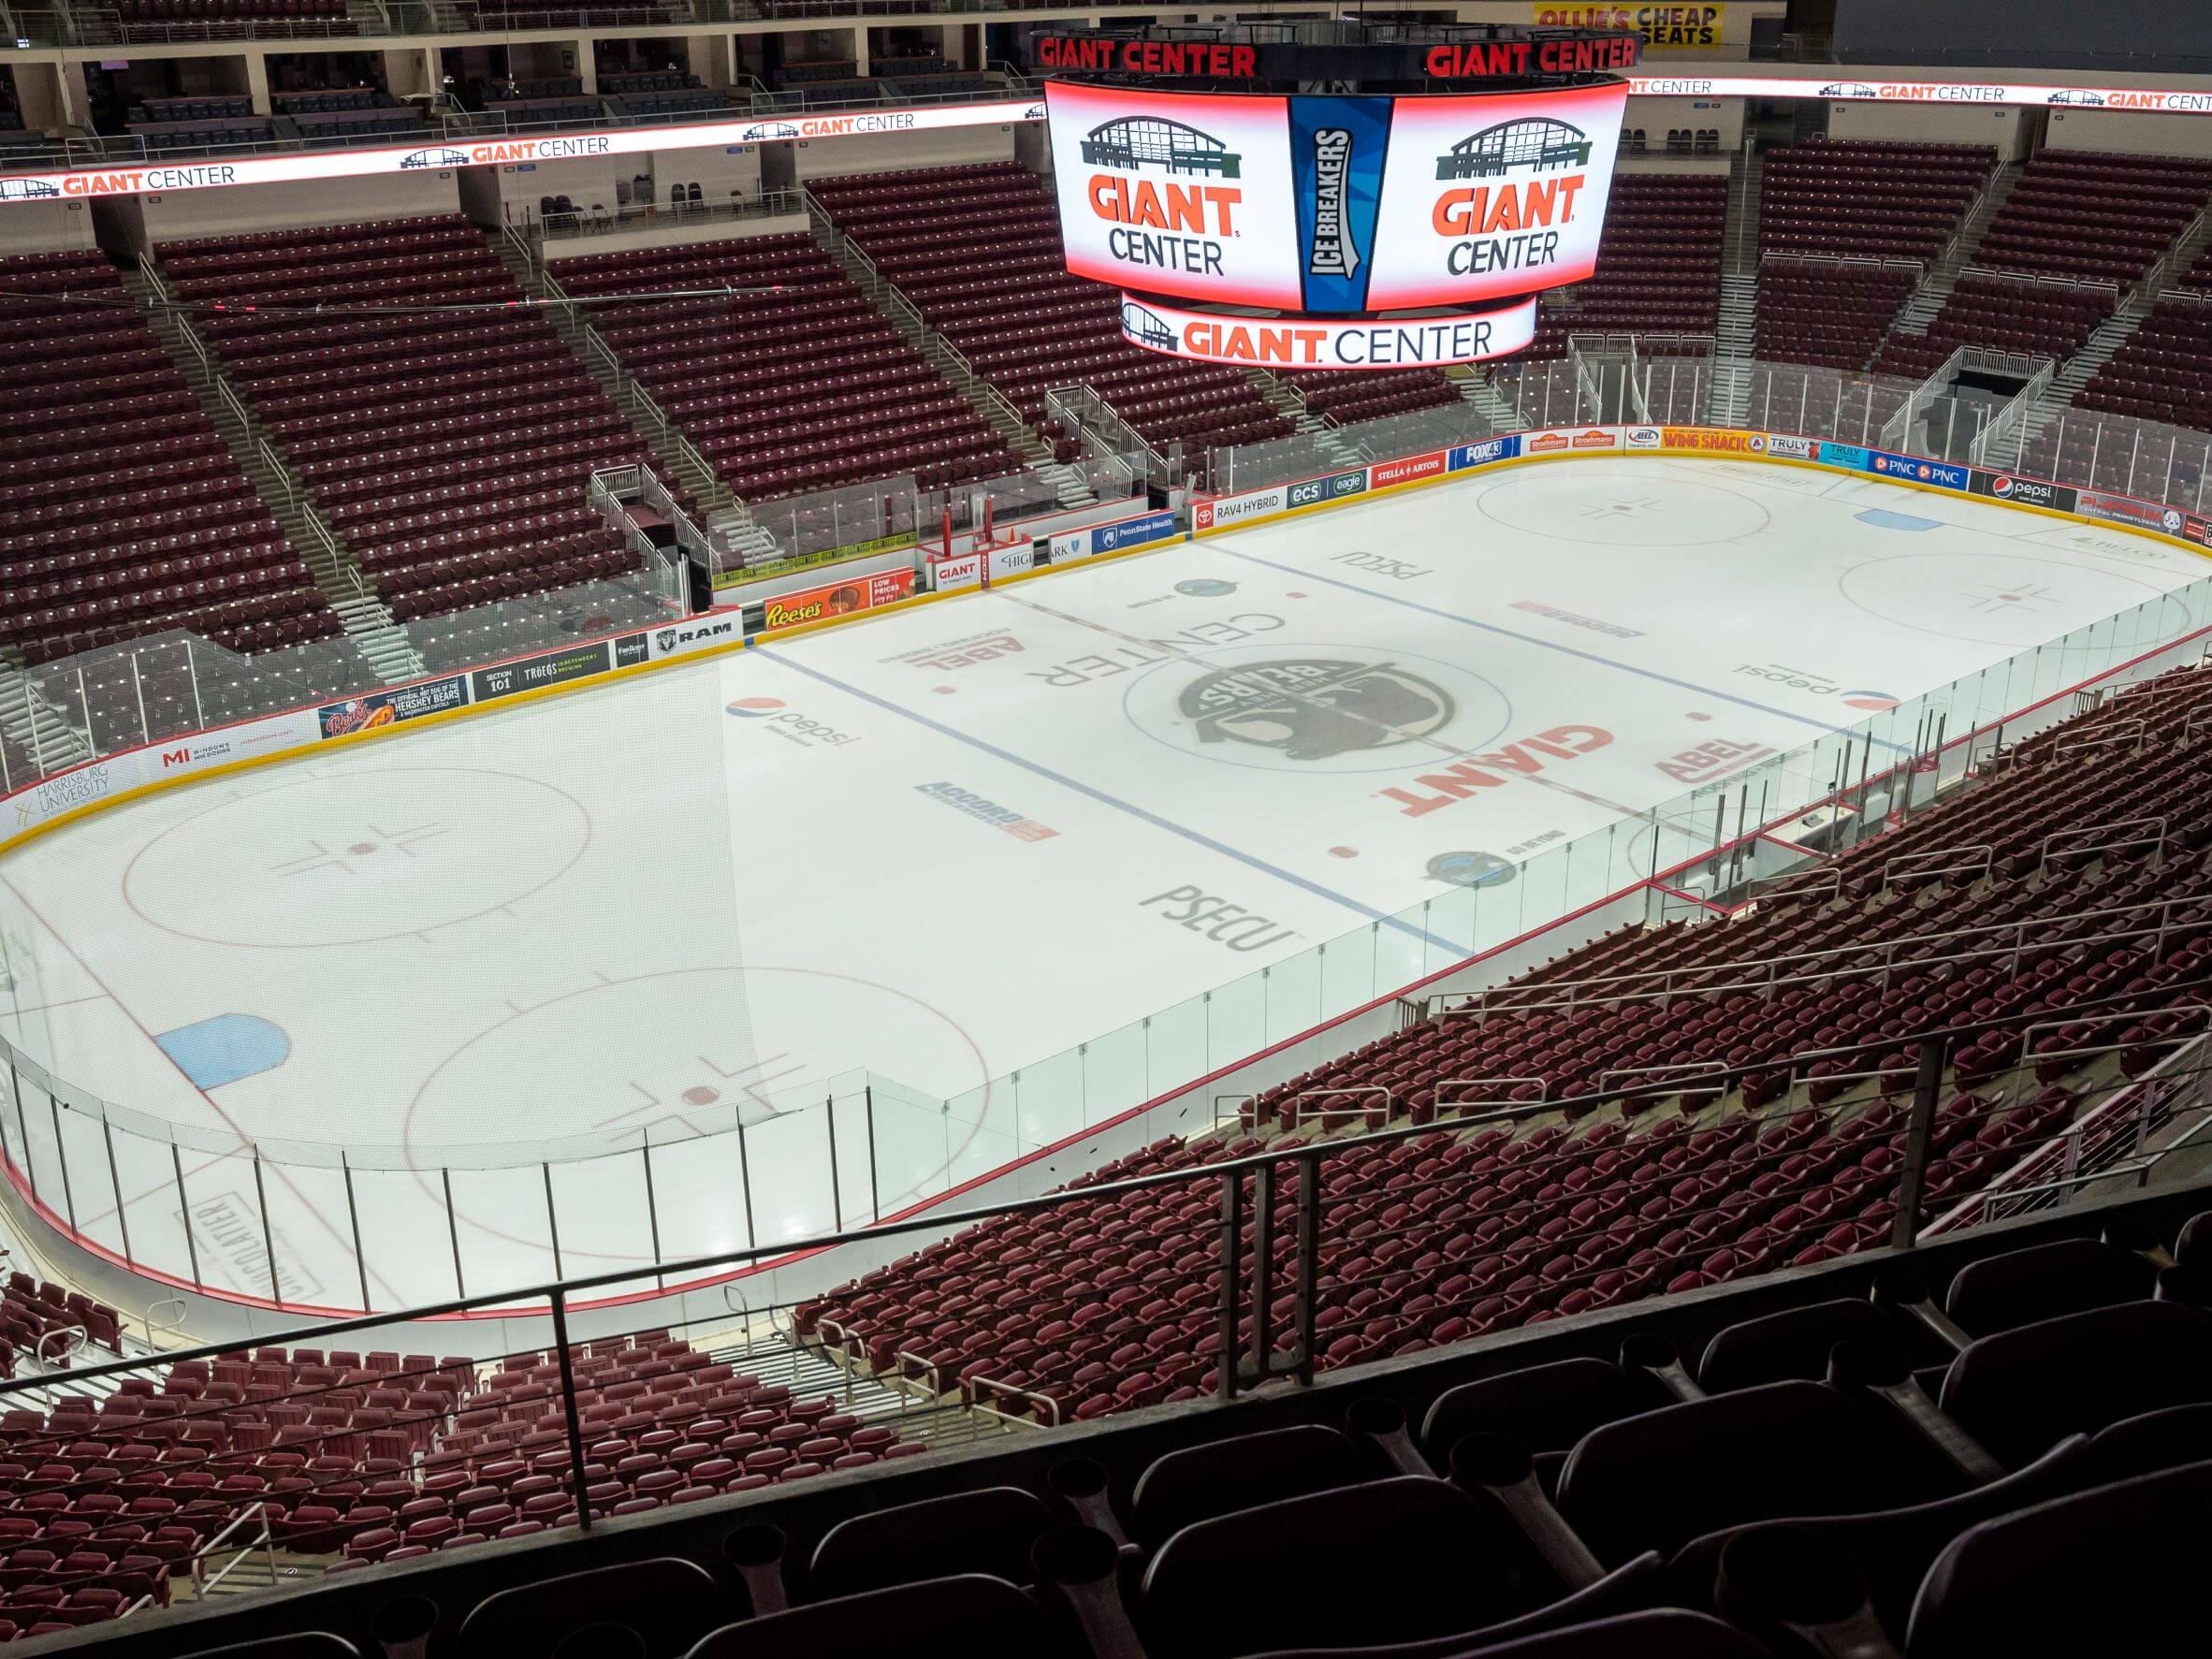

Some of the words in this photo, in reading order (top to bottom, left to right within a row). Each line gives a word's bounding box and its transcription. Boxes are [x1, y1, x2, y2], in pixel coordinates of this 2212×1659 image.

[1637, 7, 1717, 26] CHEAP
[1637, 26, 1714, 45] SEATS
[1040, 36, 1114, 70] GIANT
[1123, 41, 1256, 77] CENTER
[1426, 43, 1532, 78] GIANT
[1539, 37, 1637, 72] CENTER
[1651, 80, 1711, 94] CENTER
[1879, 85, 1936, 99] GIANT
[1938, 86, 2004, 101] CENTER
[2107, 93, 2166, 108] GIANT
[801, 119, 854, 136] GIANT
[856, 113, 914, 132] CENTER
[472, 142, 535, 162] GIANT
[539, 138, 608, 157] CENTER
[63, 172, 143, 195] GIANT
[147, 166, 234, 188] CENTER
[1316, 129, 1350, 236] BREAKERS
[1088, 174, 1242, 238] GIANT
[1432, 174, 1585, 238] GIANT
[1109, 227, 1224, 276] CENTER
[1310, 237, 1341, 275] ICE
[1447, 230, 1559, 276] CENTER
[1183, 321, 1327, 364] GIANT
[1334, 320, 1492, 365] CENTER
[1531, 439, 1566, 448] Stroehmann
[1575, 435, 1613, 444] Stroehmann
[1634, 429, 1654, 440] AHL
[1663, 432, 1699, 448] WING
[1701, 434, 1747, 451] SHACK
[1770, 437, 1807, 450] TRULY
[1466, 441, 1503, 462] FOX43
[1830, 444, 1861, 457] TRULY
[1377, 469, 1404, 481] STELLA
[1412, 459, 1439, 473] ARTOIS
[1889, 459, 1915, 475] PNC
[1932, 470, 1959, 484] PNC
[1292, 485, 1319, 502] ecs
[1336, 475, 1361, 491] eagle
[2015, 481, 2052, 499] pepsi
[1217, 502, 1242, 518] RAV4
[1244, 495, 1279, 514] HYBRID
[2079, 506, 2111, 517] CENTRAL
[2112, 512, 2161, 528] PENNSYLVANIA
[1152, 517, 1173, 530] Health
[939, 562, 976, 579] GIANT
[1331, 550, 1433, 580] PSECU
[874, 578, 890, 589] LOW
[874, 584, 900, 595] PRICES
[765, 601, 823, 628] Reese's
[678, 622, 732, 643] RAM
[913, 636, 1026, 671] ABEL
[1025, 613, 1286, 688] CENTER
[487, 669, 512, 682] SECTION
[490, 677, 511, 692] 101
[1731, 663, 1841, 695] pepsi
[394, 696, 431, 713] HERSHEY
[433, 689, 459, 704] BEARS
[1238, 676, 1332, 707] HERHEY
[327, 698, 372, 737] Berks
[770, 711, 861, 749] pepsi
[163, 748, 190, 768] MI
[193, 742, 230, 755] WINDOWS
[207, 748, 231, 758] DOORS
[1654, 737, 1762, 782] ABEL
[37, 763, 109, 799] HARRISBURG
[1376, 724, 1615, 819] GIANT
[40, 776, 109, 812] UNIVERSITY
[913, 781, 1026, 823] ACCORD
[1138, 883, 1297, 953] PSECU
